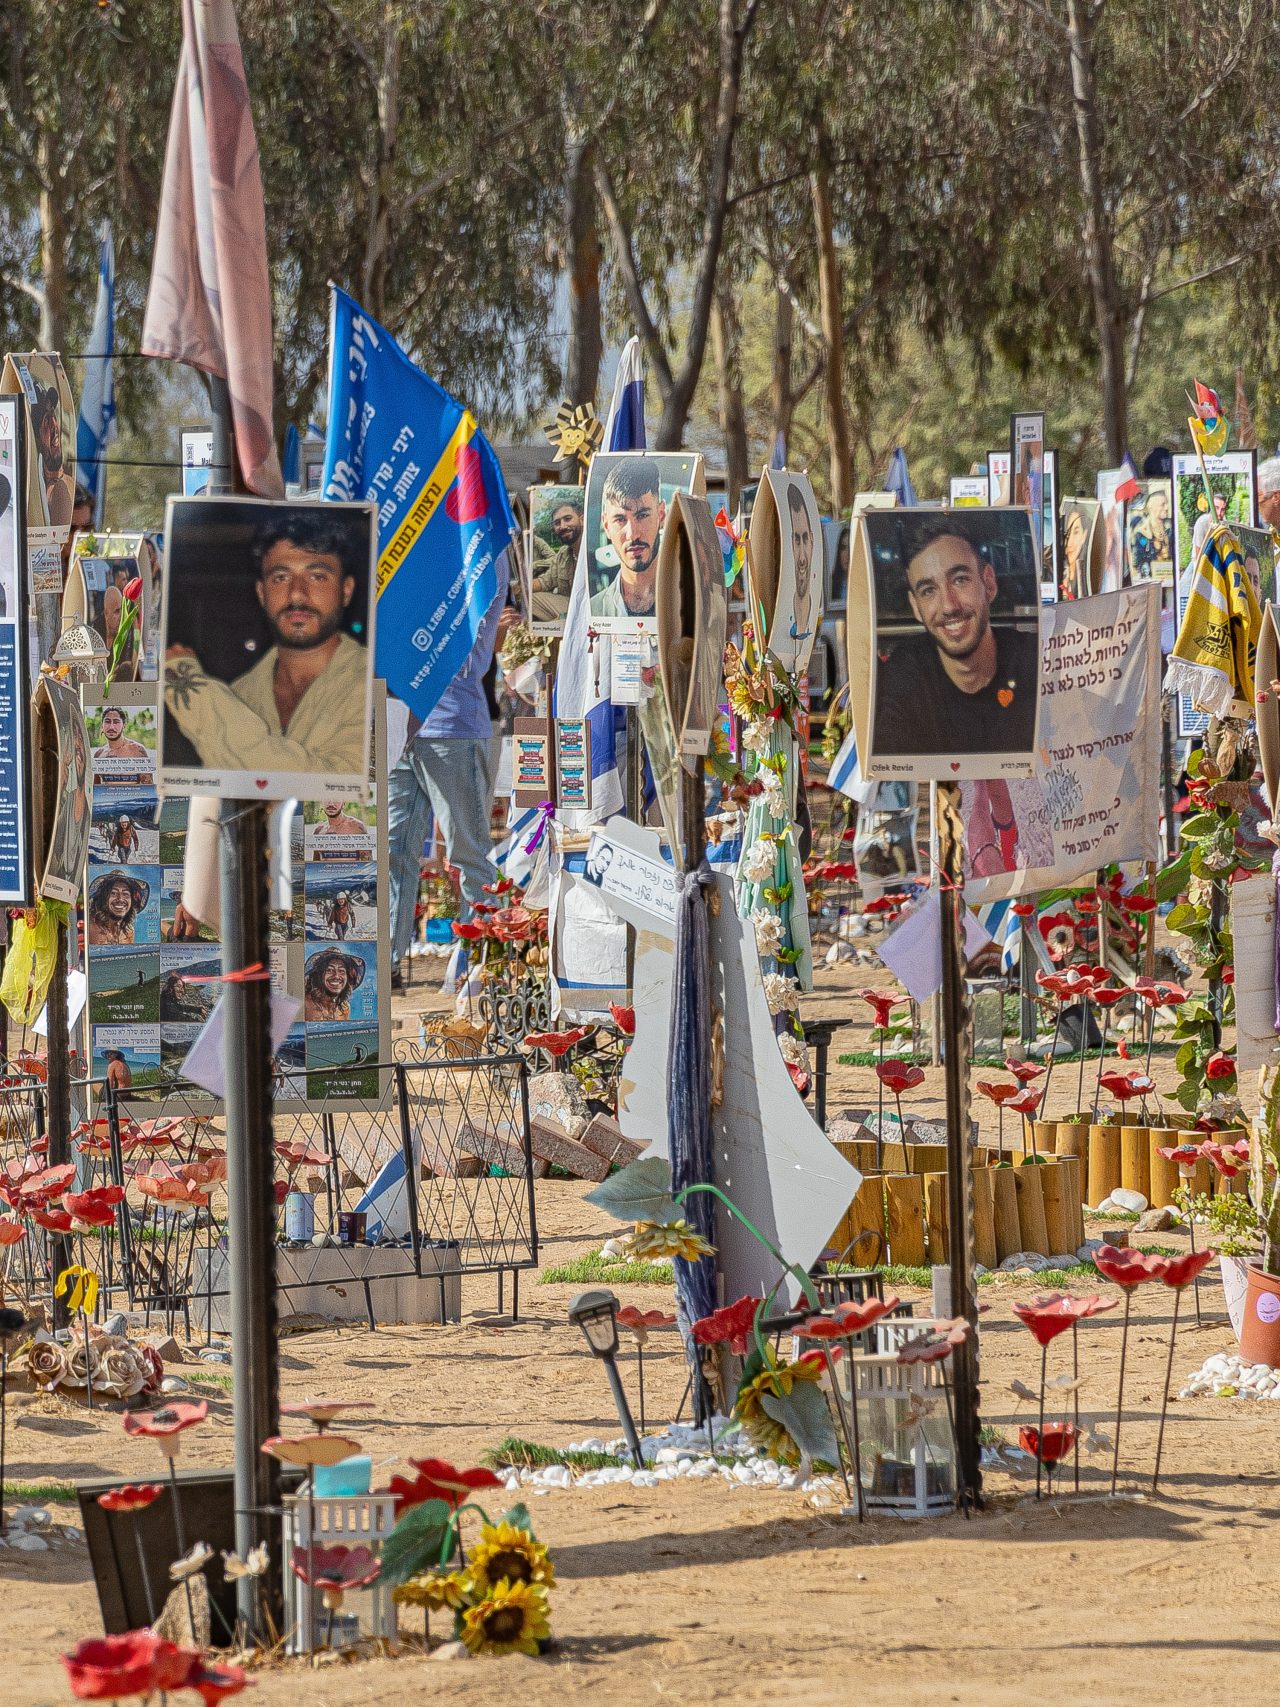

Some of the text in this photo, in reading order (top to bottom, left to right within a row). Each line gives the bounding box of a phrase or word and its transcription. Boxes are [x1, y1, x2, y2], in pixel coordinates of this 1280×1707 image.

[392, 425, 415, 453] ליבי
[372, 461, 394, 490] קרן
[393, 461, 421, 502] צחוק,
[388, 482, 442, 562] נרצחה בטבח
[1043, 628, 1084, 651] להנות,
[1087, 625, 1114, 648] הזמן
[1058, 667, 1123, 692] כי כלום לא
[872, 764, 914, 772] Ofek Ravia
